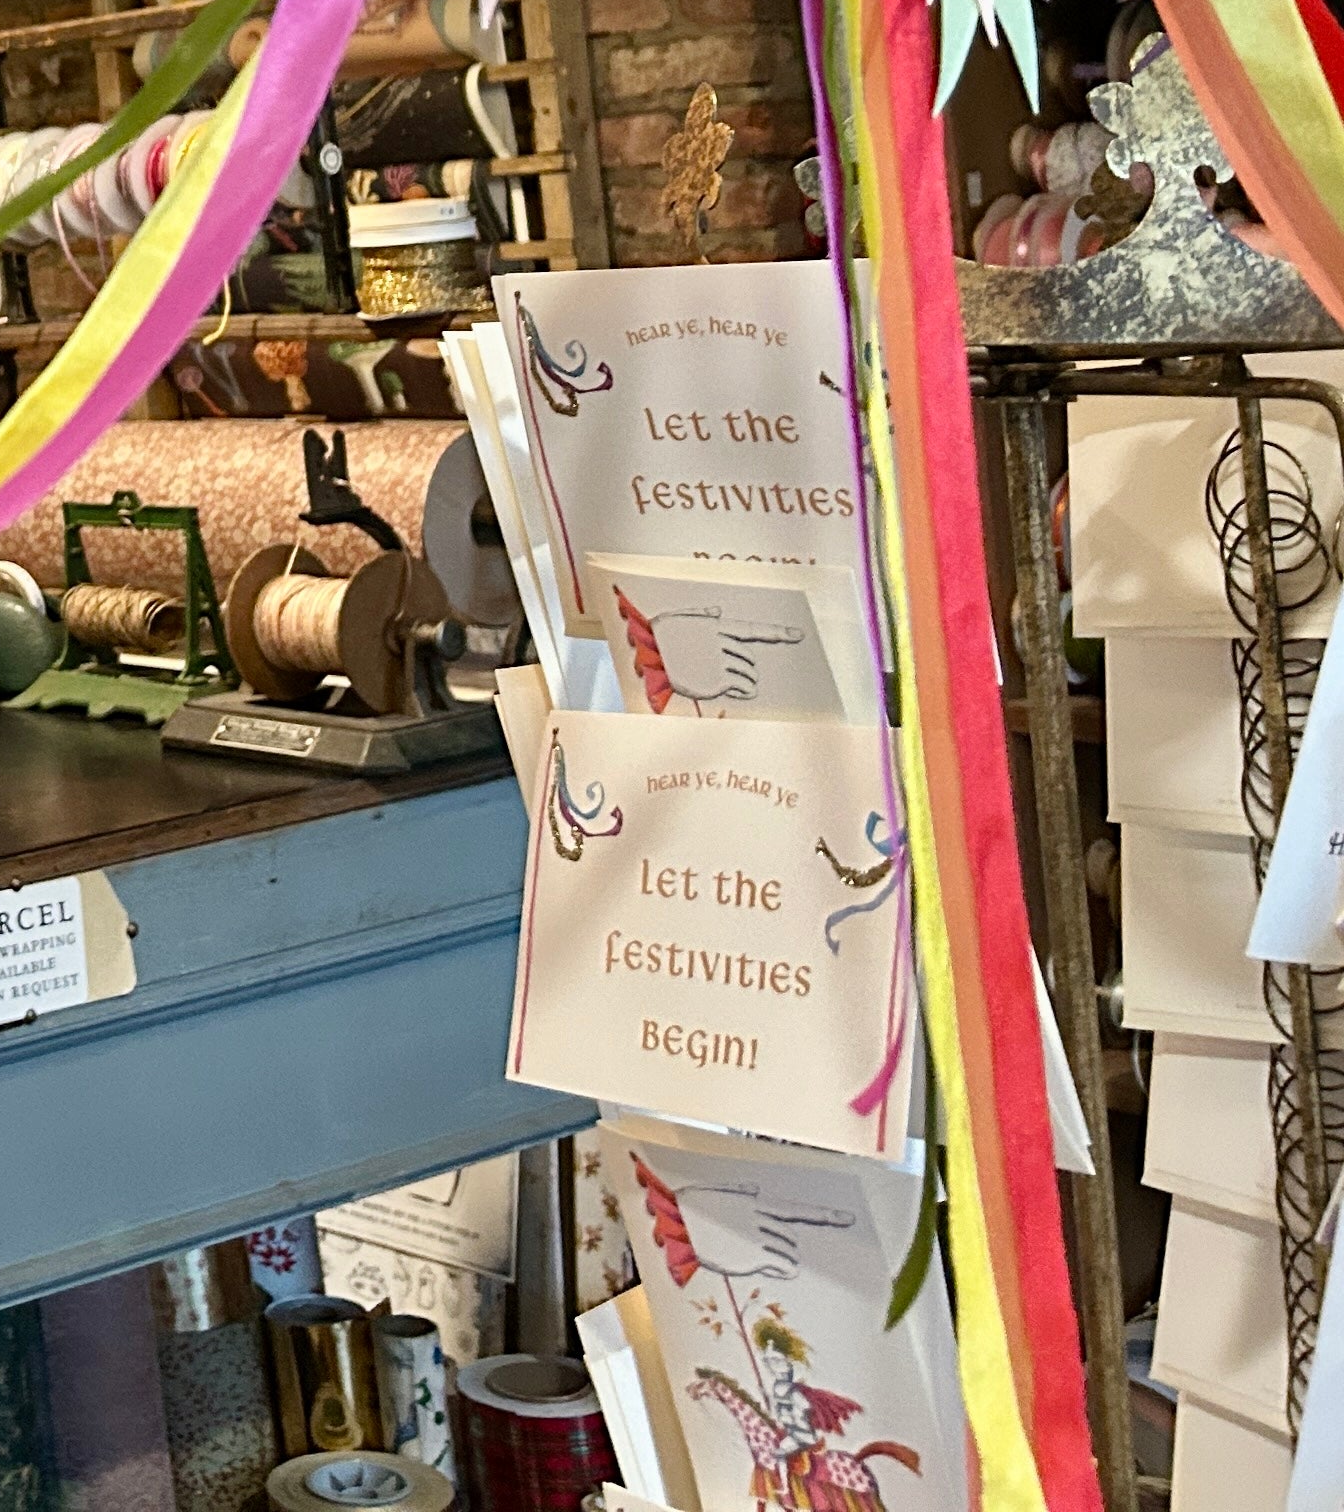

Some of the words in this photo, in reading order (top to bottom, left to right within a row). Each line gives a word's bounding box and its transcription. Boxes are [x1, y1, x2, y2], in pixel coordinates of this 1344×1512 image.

[722, 409, 800, 444] the
[713, 870, 782, 912] the
[11, 973, 80, 997] REQUEST
